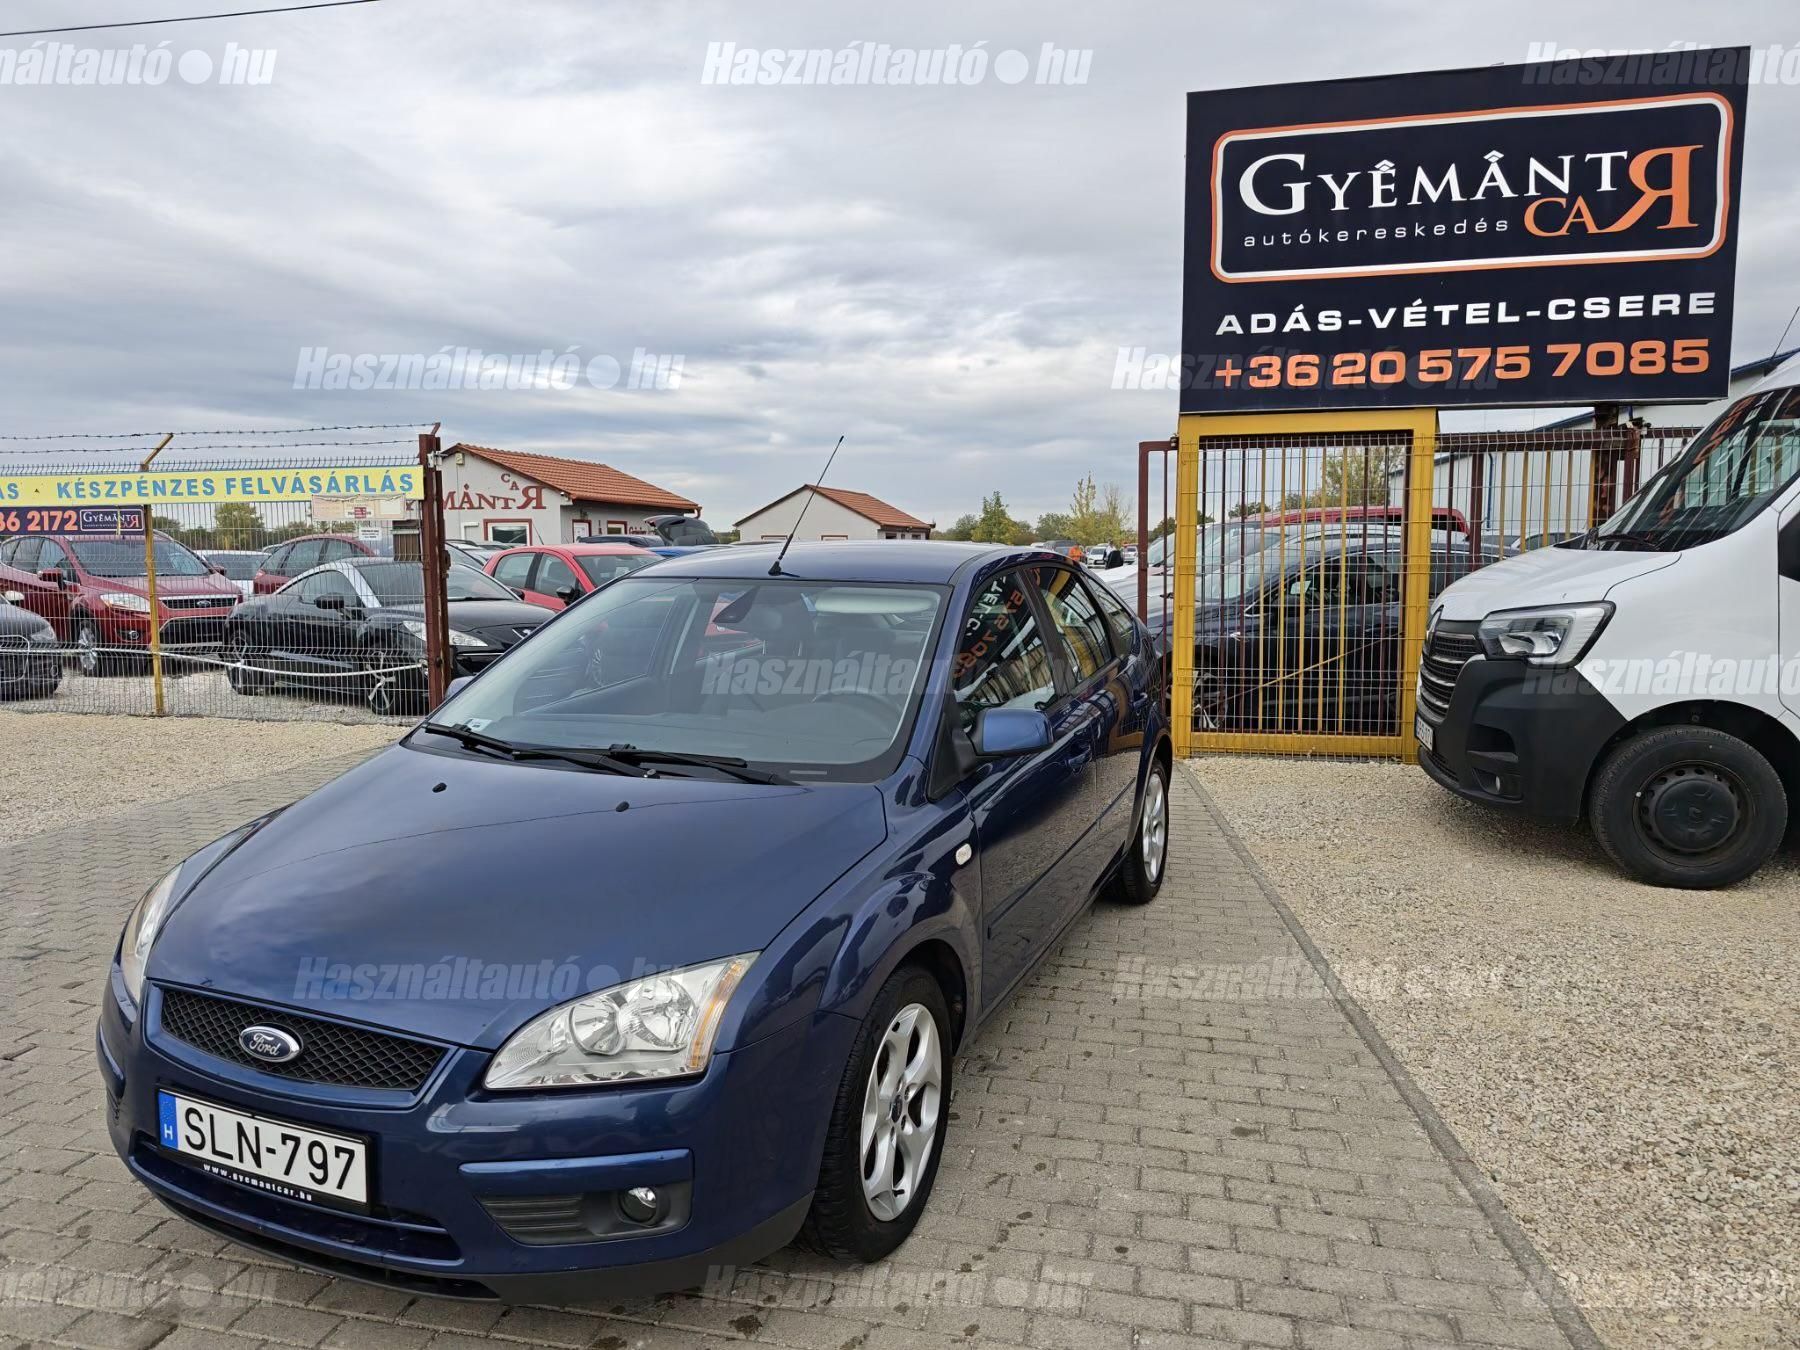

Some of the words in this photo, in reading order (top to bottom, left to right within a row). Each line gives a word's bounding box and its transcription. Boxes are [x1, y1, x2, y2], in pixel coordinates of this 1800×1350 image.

[1243, 217, 1508, 248] autókereskedés
[1215, 291, 1716, 336] ADÁS-VÉTEL-CSERE
[1215, 353, 1320, 389] +36
[1332, 351, 1406, 385] 20
[1418, 344, 1531, 383] 575
[1546, 337, 1710, 378] 7085
[56, 476, 216, 499] KÉSZPÉNZES
[225, 470, 414, 495] FELVÁSÁRLÁS
[26, 510, 78, 531] 2172
[249, 1032, 281, 1056] Ford
[163, 1123, 173, 1141] H
[184, 1106, 356, 1190] SLN-797
